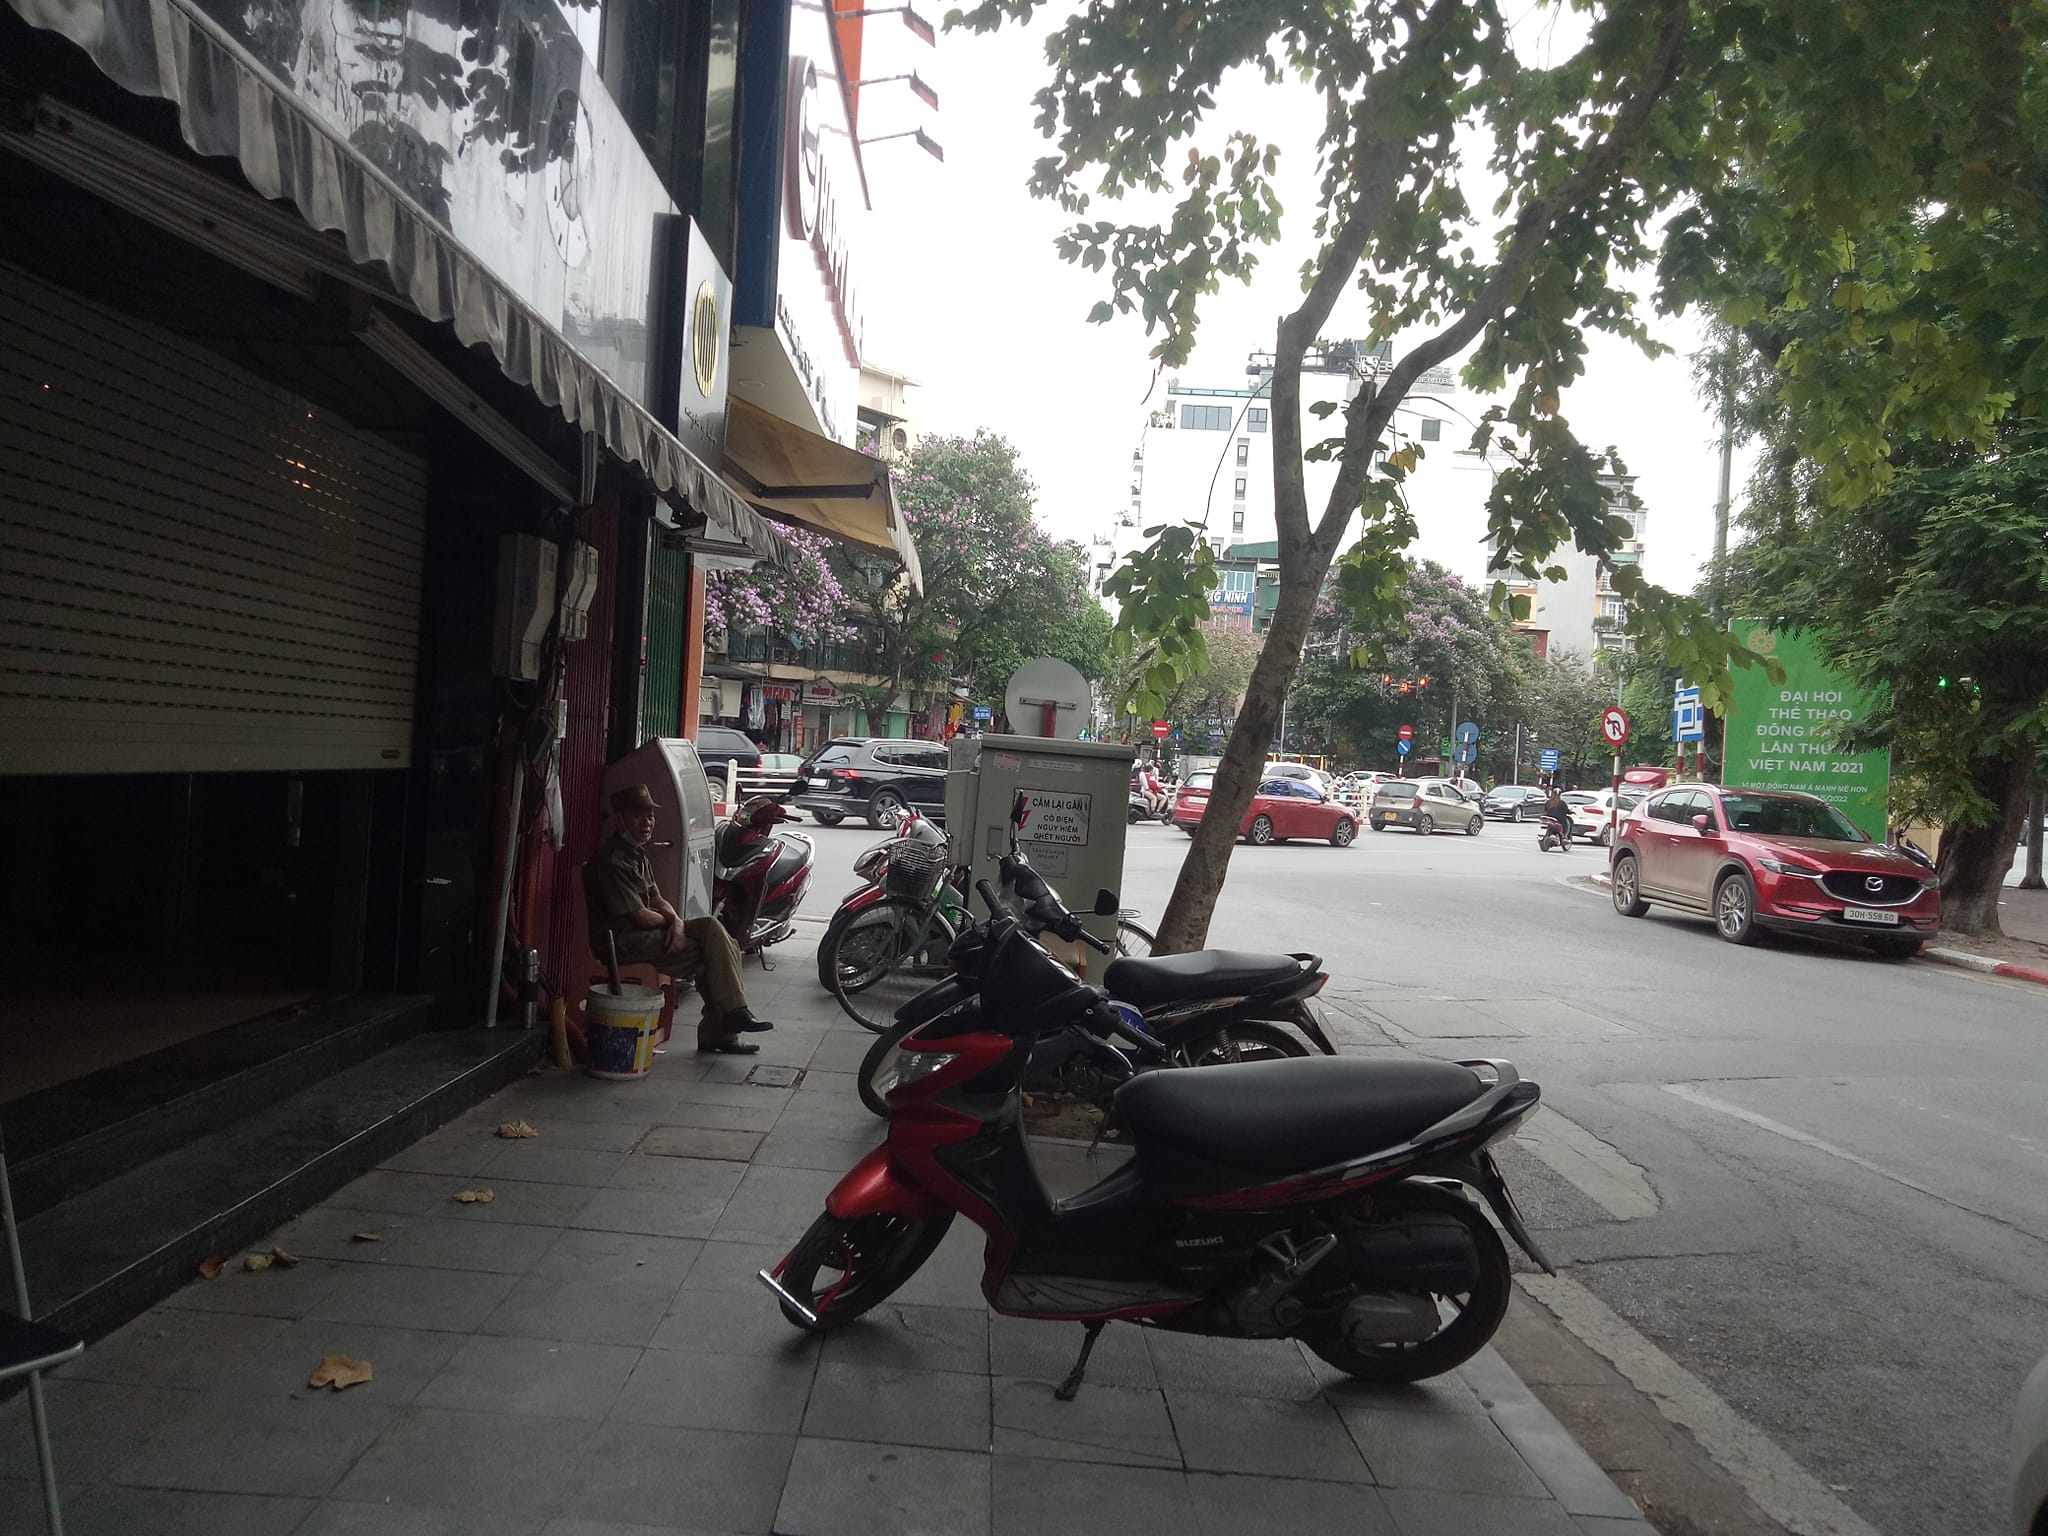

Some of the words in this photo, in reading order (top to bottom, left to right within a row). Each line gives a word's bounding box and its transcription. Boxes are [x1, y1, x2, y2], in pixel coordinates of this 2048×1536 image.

[1224, 591, 1248, 604] NINH
[1780, 690, 1808, 705] ĐẠI
[1813, 689, 1842, 705] HỘI
[1805, 708, 1852, 721] THAO
[1756, 722, 1804, 737] ĐÔNG
[1749, 757, 1785, 773] VIỆT
[1789, 760, 1826, 772] NAM
[1831, 762, 1864, 774] 2021
[1789, 783, 1807, 791] NAM
[1051, 799, 1065, 811] LẠI
[1043, 812, 1055, 822] CÓ
[1056, 815, 1074, 824] ĐIỆN
[1037, 823, 1059, 832] NGUY
